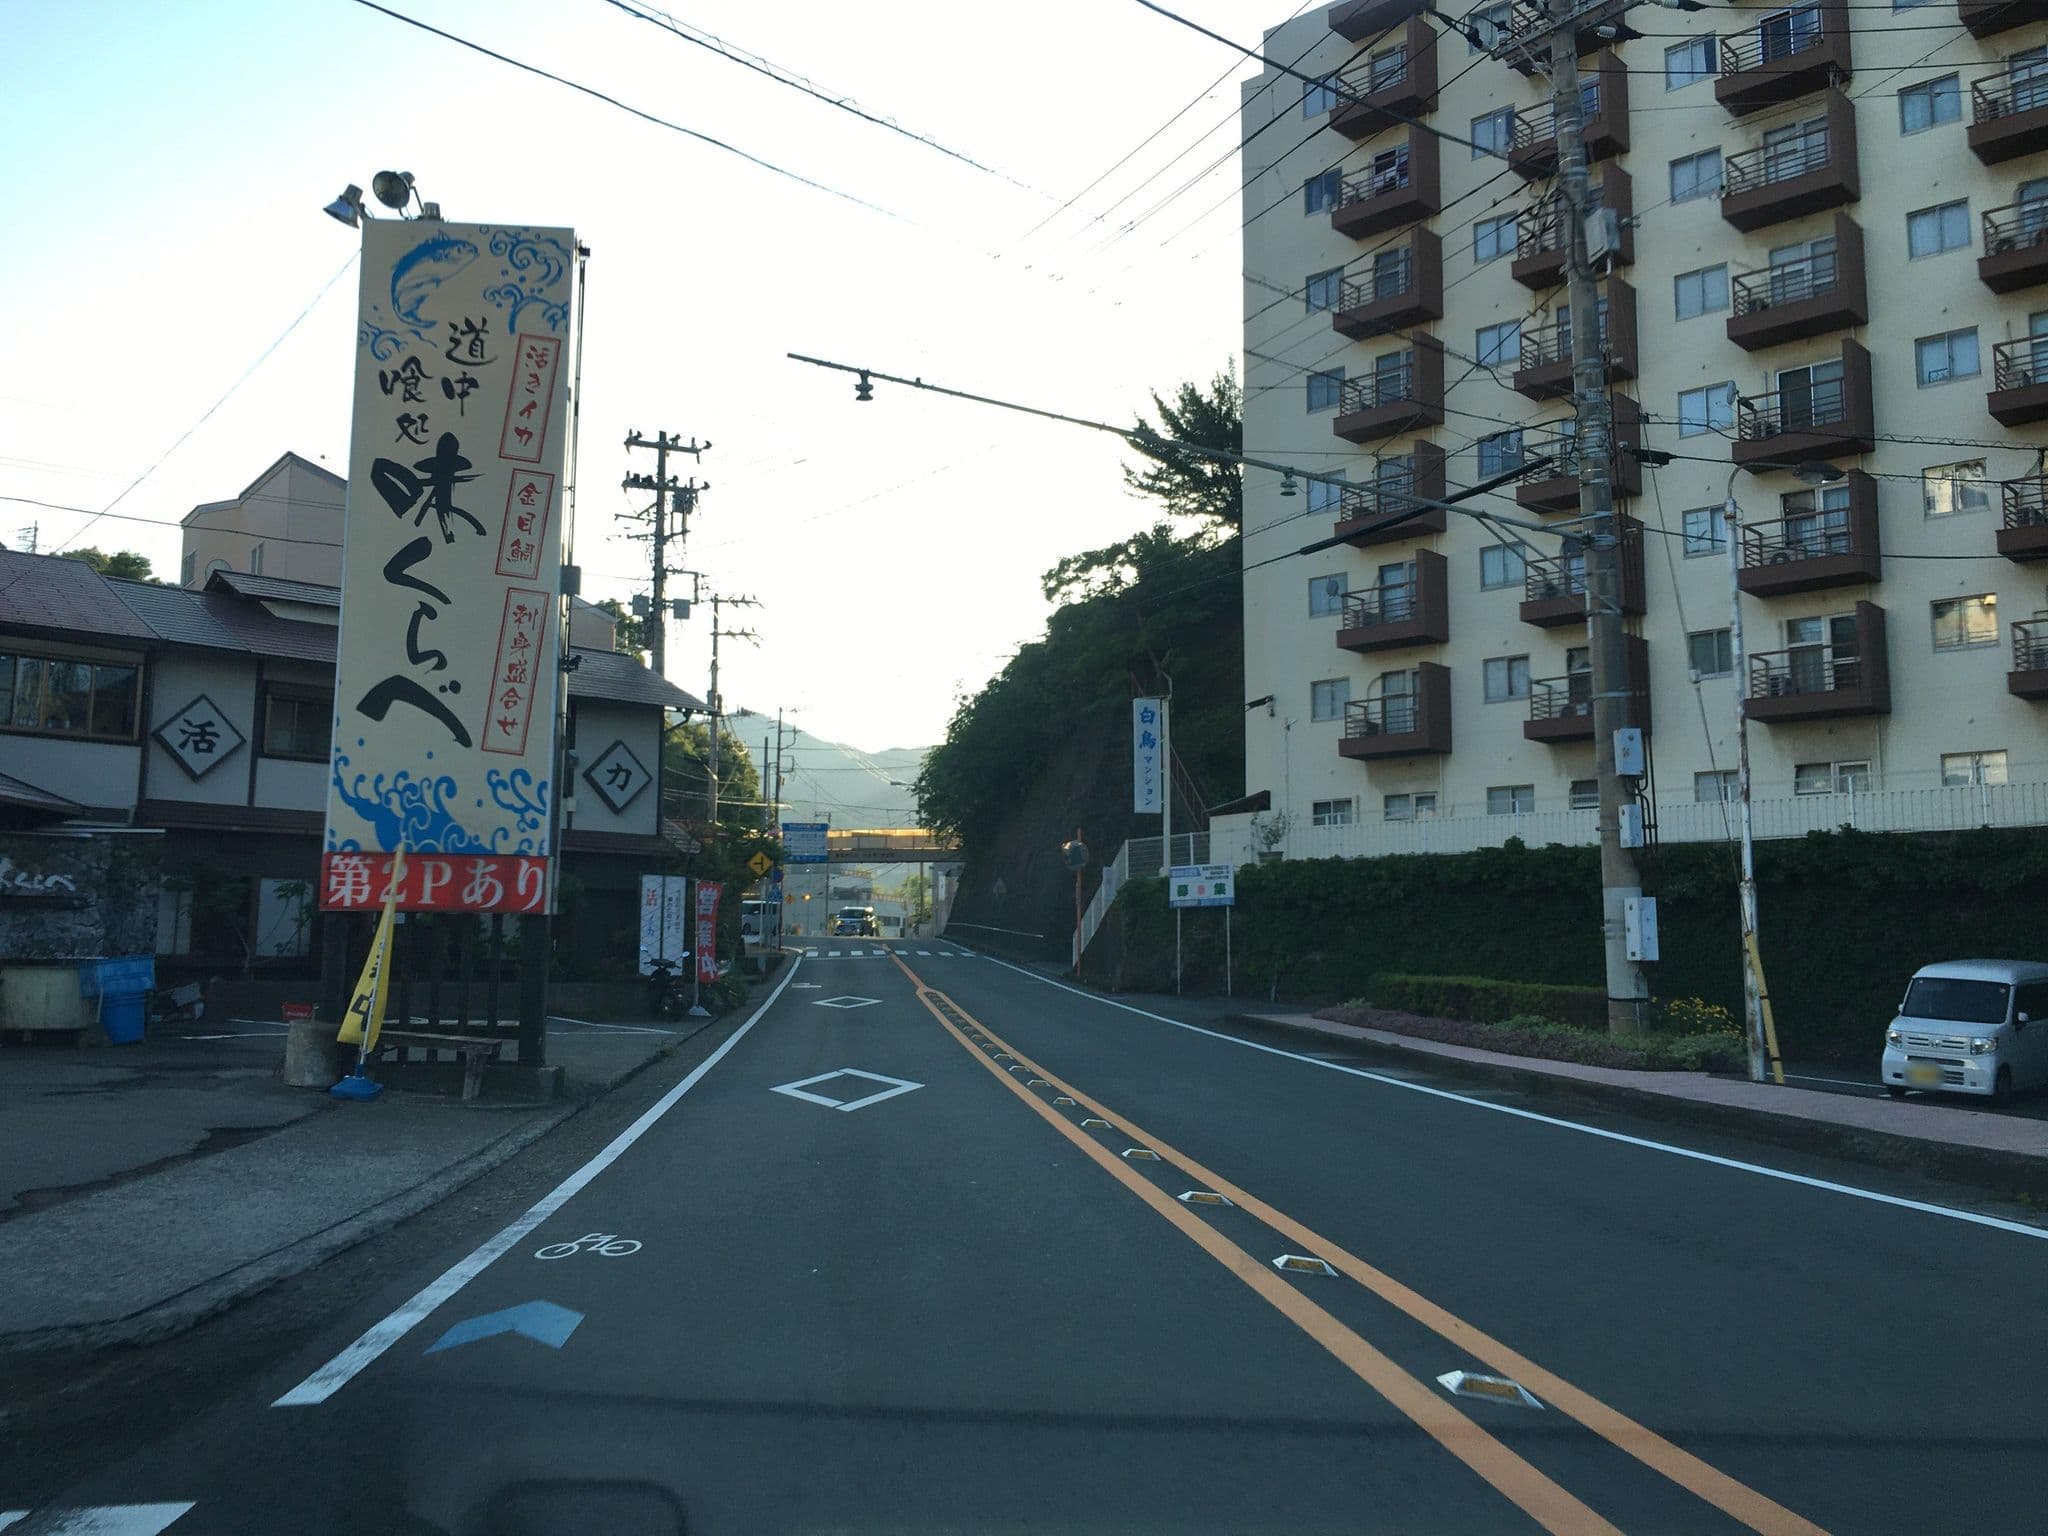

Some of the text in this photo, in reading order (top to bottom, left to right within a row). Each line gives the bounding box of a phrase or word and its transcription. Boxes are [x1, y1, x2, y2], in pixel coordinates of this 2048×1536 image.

[441, 316, 498, 416] 道中
[514, 345, 550, 448] 活きイカ
[507, 482, 543, 563] 金目鯛
[355, 431, 487, 748] 味くらべ
[498, 603, 539, 737] 刺身盛合せ
[178, 718, 220, 754] 活
[1139, 706, 1157, 806] 白鳥マンション
[698, 887, 719, 979] 営業中
